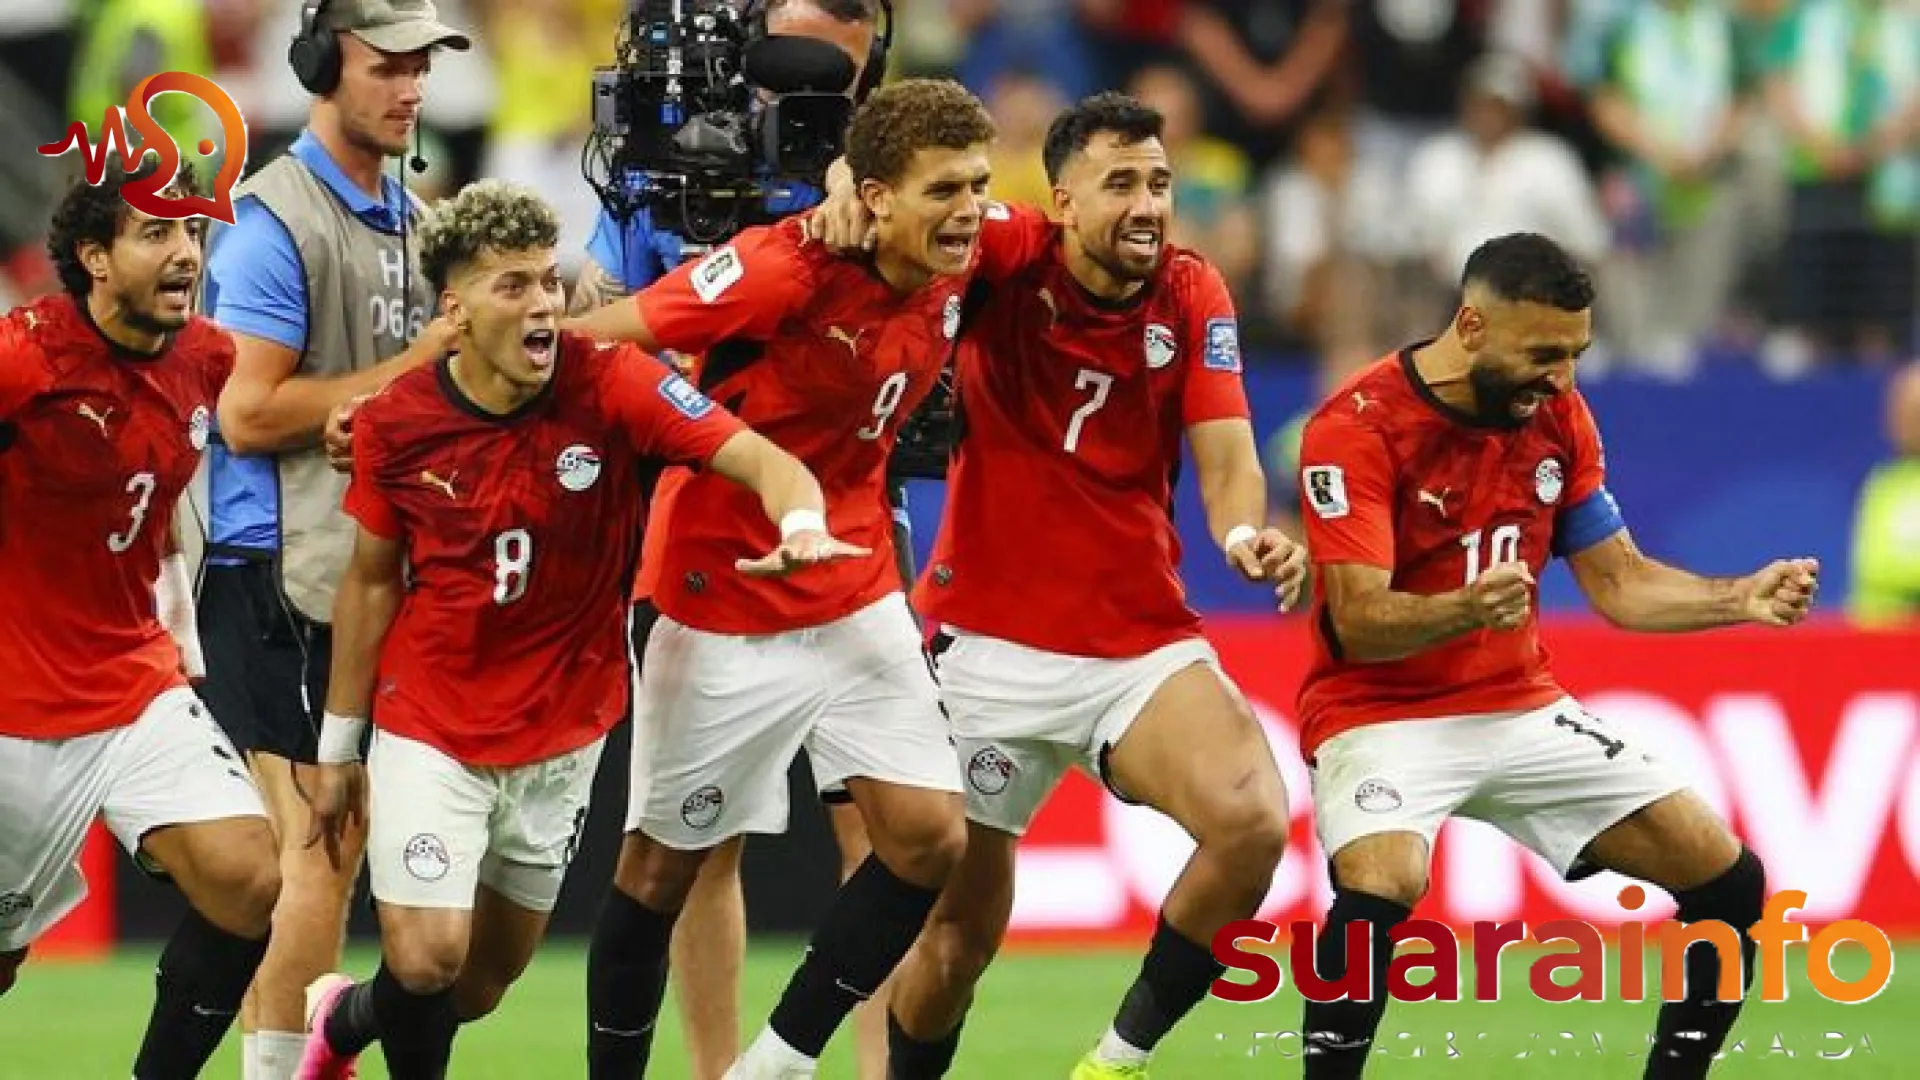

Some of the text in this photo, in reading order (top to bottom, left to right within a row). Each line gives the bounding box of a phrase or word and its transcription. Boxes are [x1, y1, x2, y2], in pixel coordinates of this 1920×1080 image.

[857, 371, 906, 439] 9
[1064, 368, 1113, 453] 7
[107, 472, 155, 551] 3
[494, 529, 530, 604] 8
